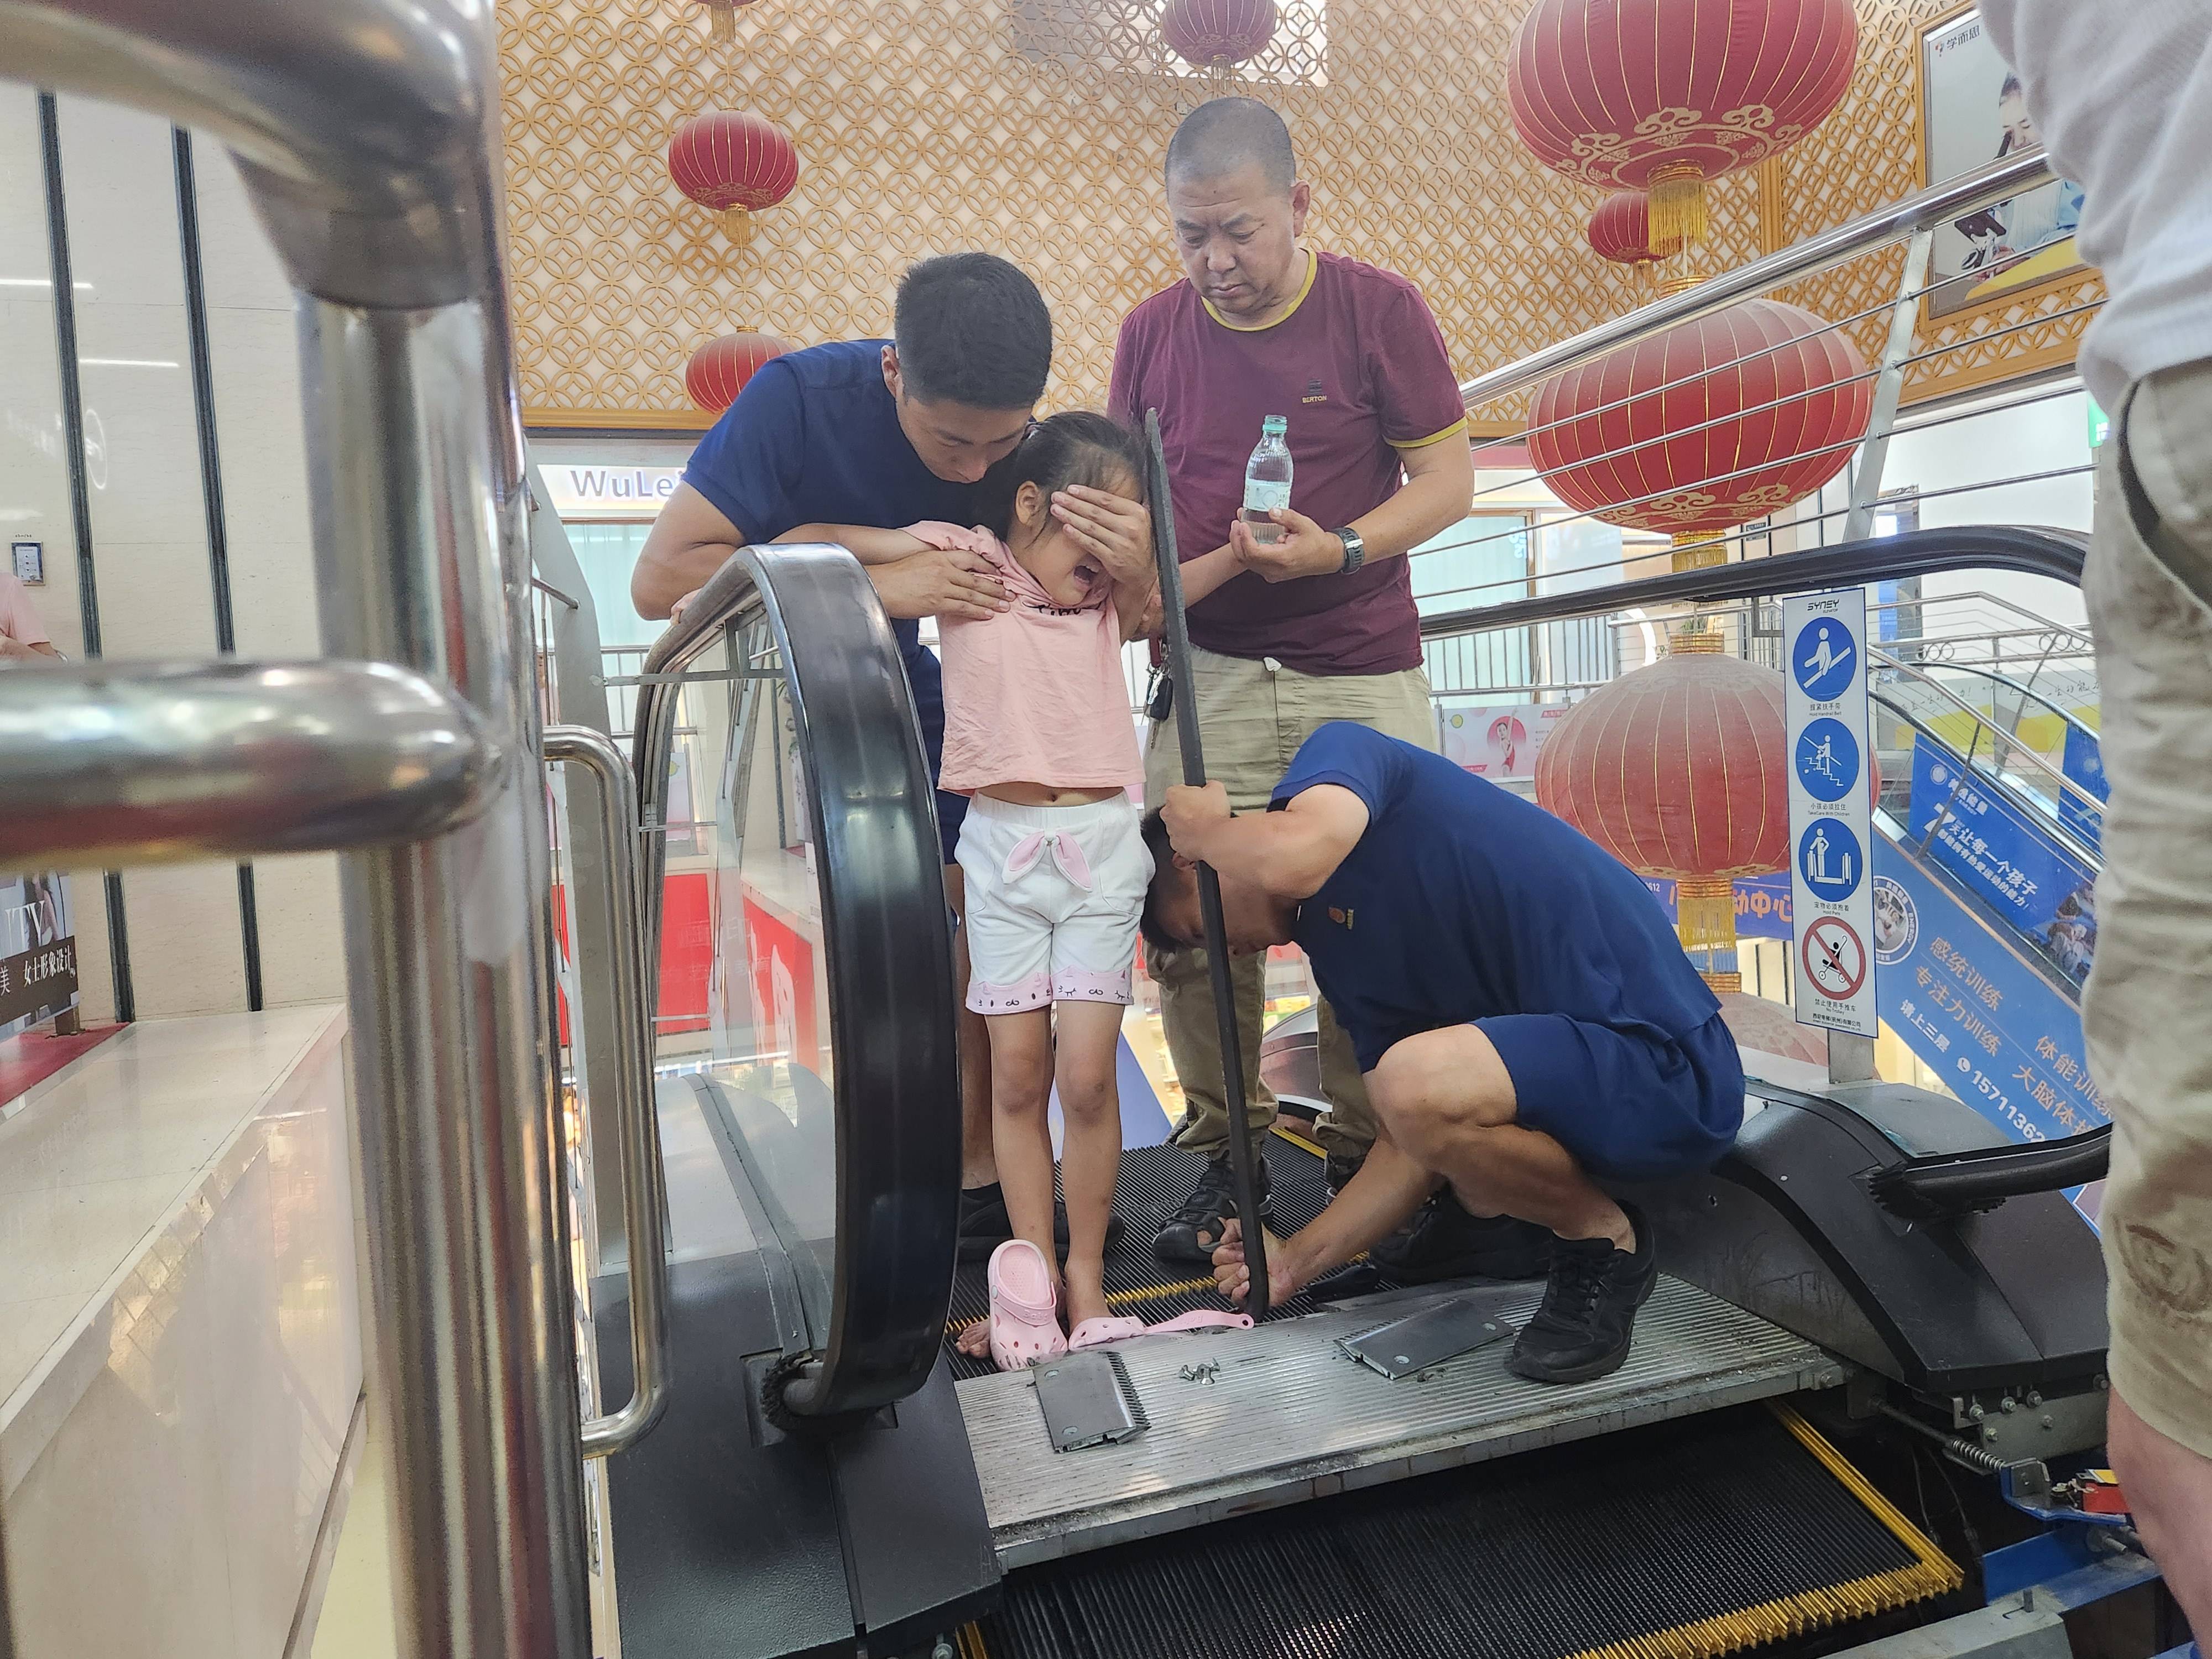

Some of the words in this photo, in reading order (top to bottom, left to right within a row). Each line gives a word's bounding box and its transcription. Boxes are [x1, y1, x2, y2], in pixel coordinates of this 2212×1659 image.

[1947, 25, 1980, 50] 学而思
[570, 470, 684, 497] WuLe
[23, 945, 71, 988] 女士形象设计
[1930, 937, 2003, 1011] 感统训练
[1900, 999, 1950, 1053] 请上三层
[1917, 966, 2001, 1057] 专注力训练
[2035, 1036, 2114, 1120] 体能训练
